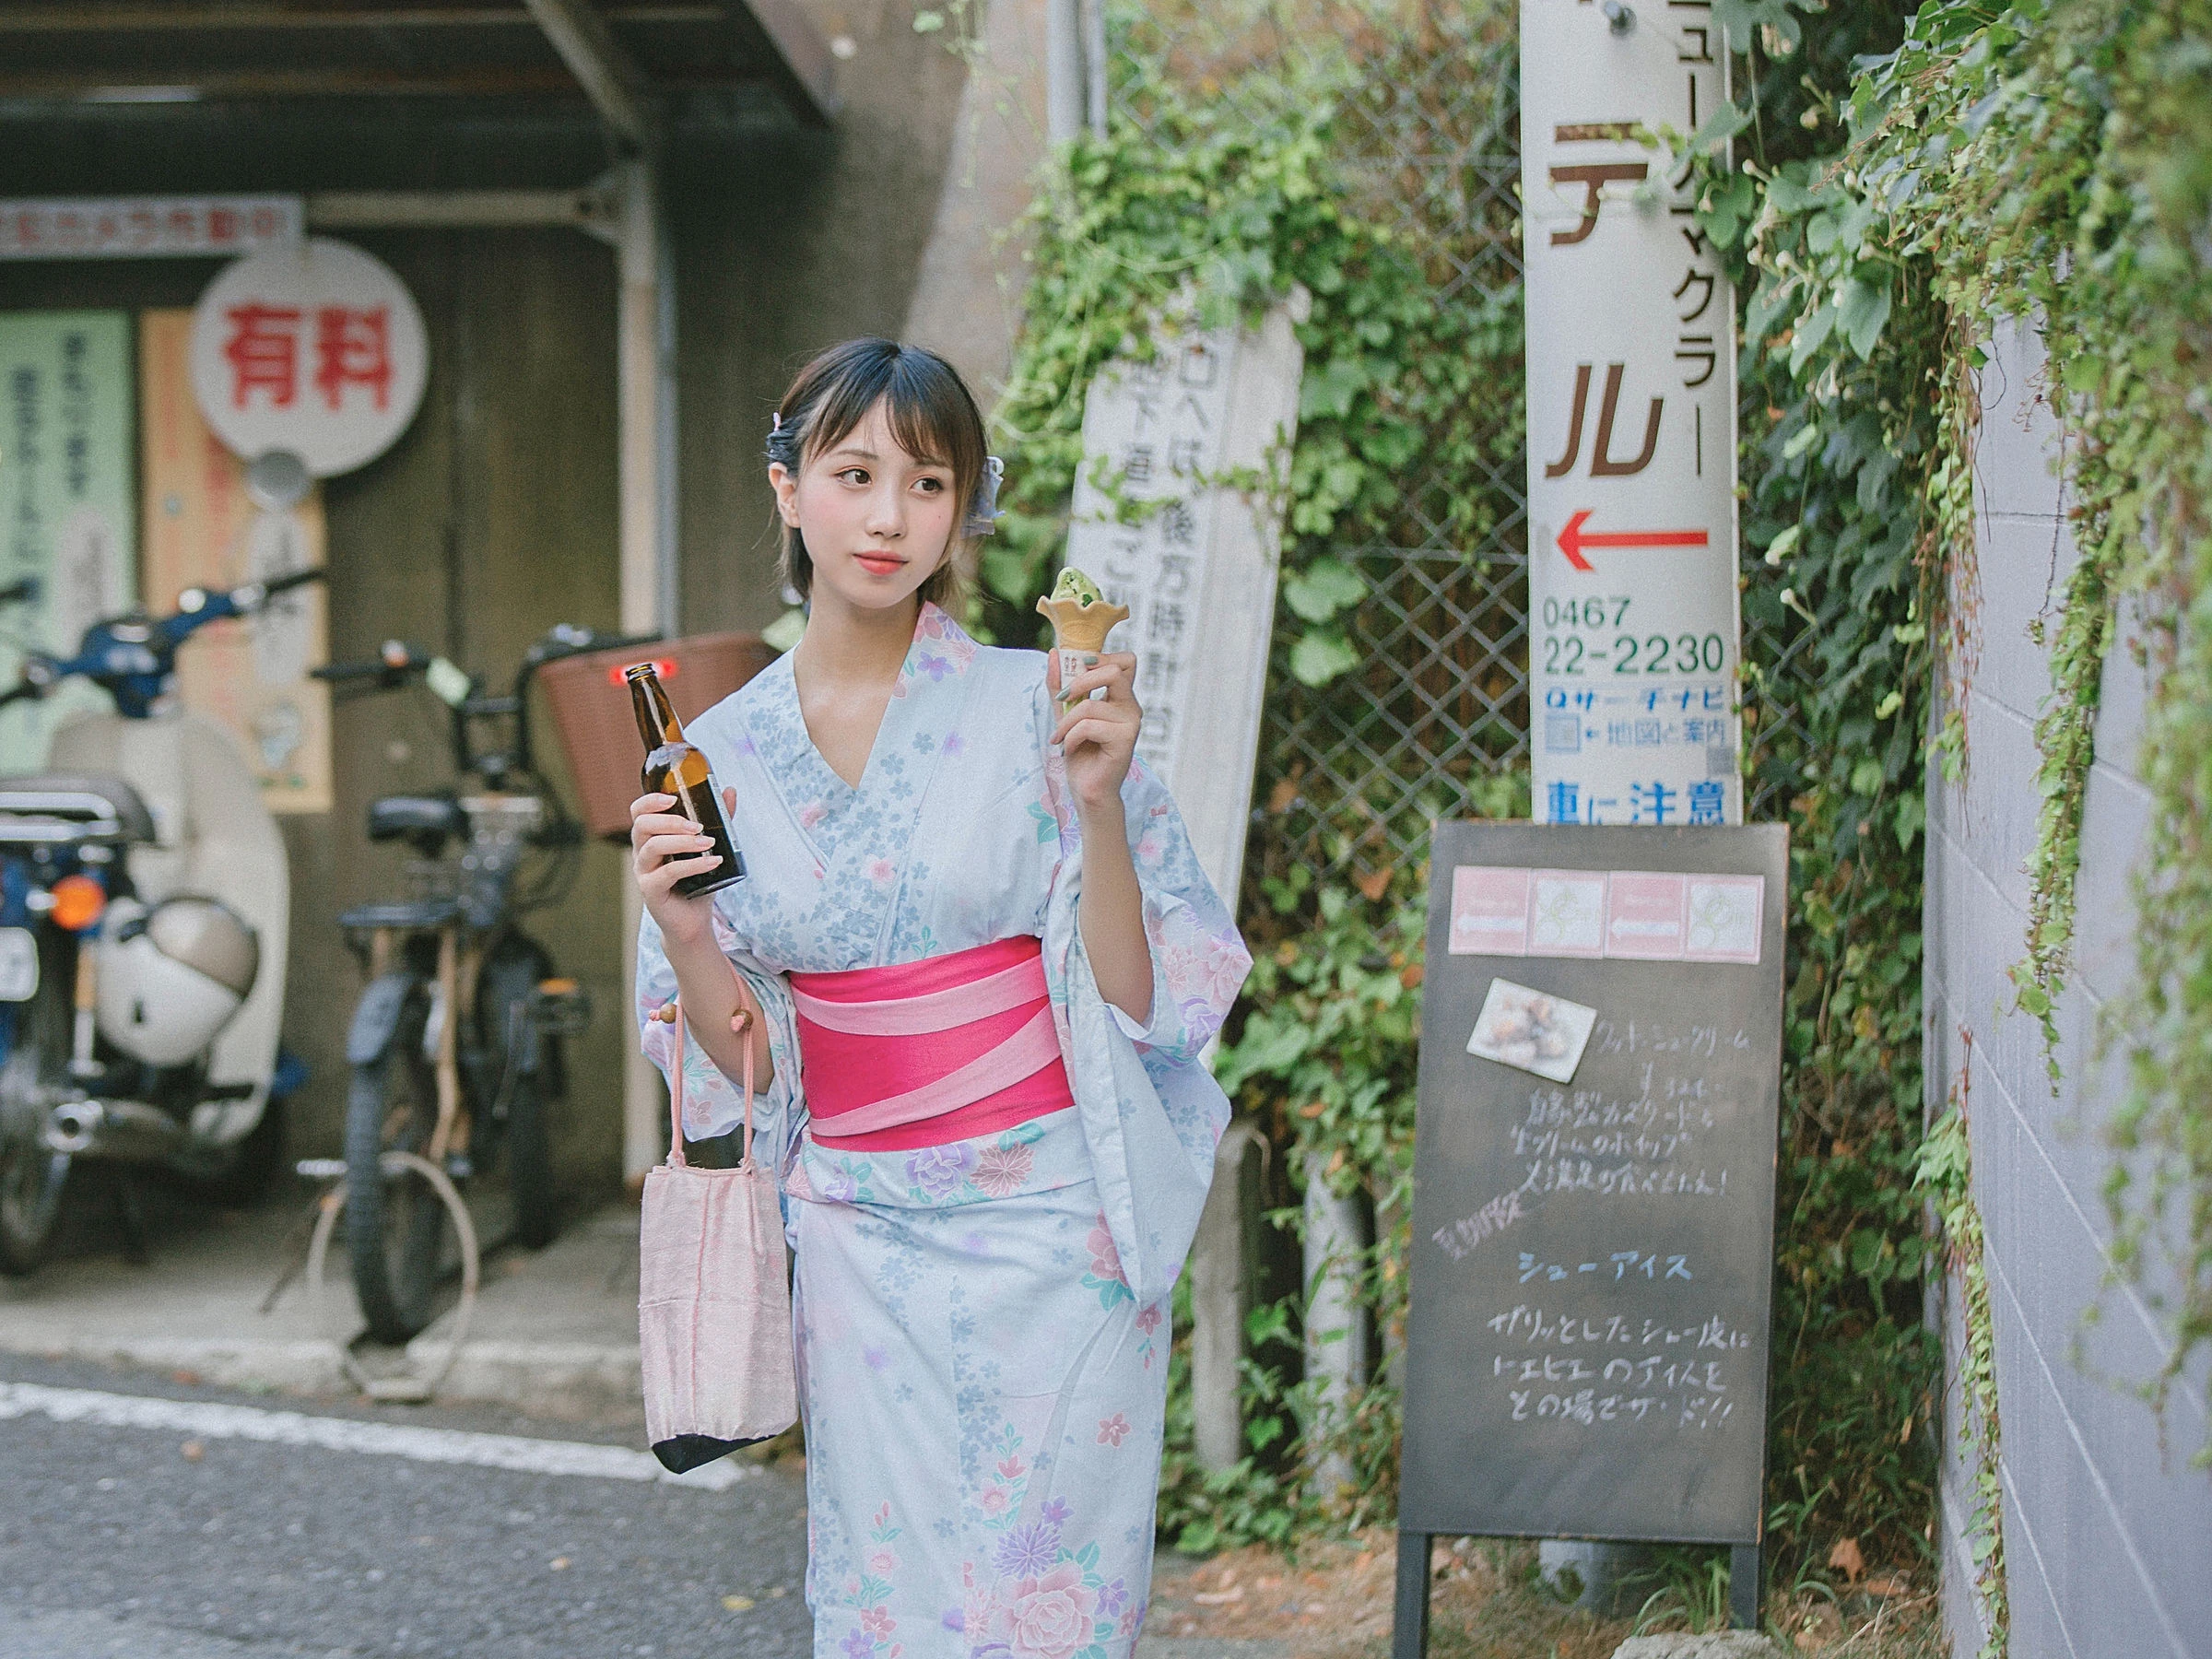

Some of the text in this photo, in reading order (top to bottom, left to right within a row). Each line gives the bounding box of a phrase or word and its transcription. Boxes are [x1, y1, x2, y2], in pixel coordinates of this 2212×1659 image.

[223, 299, 392, 412] 有料
[1543, 595, 1630, 629] 0467
[1545, 632, 1724, 675] 22-2230
[1547, 781, 1724, 825] 車に注意
[1517, 1251, 1693, 1284] シューアイス
